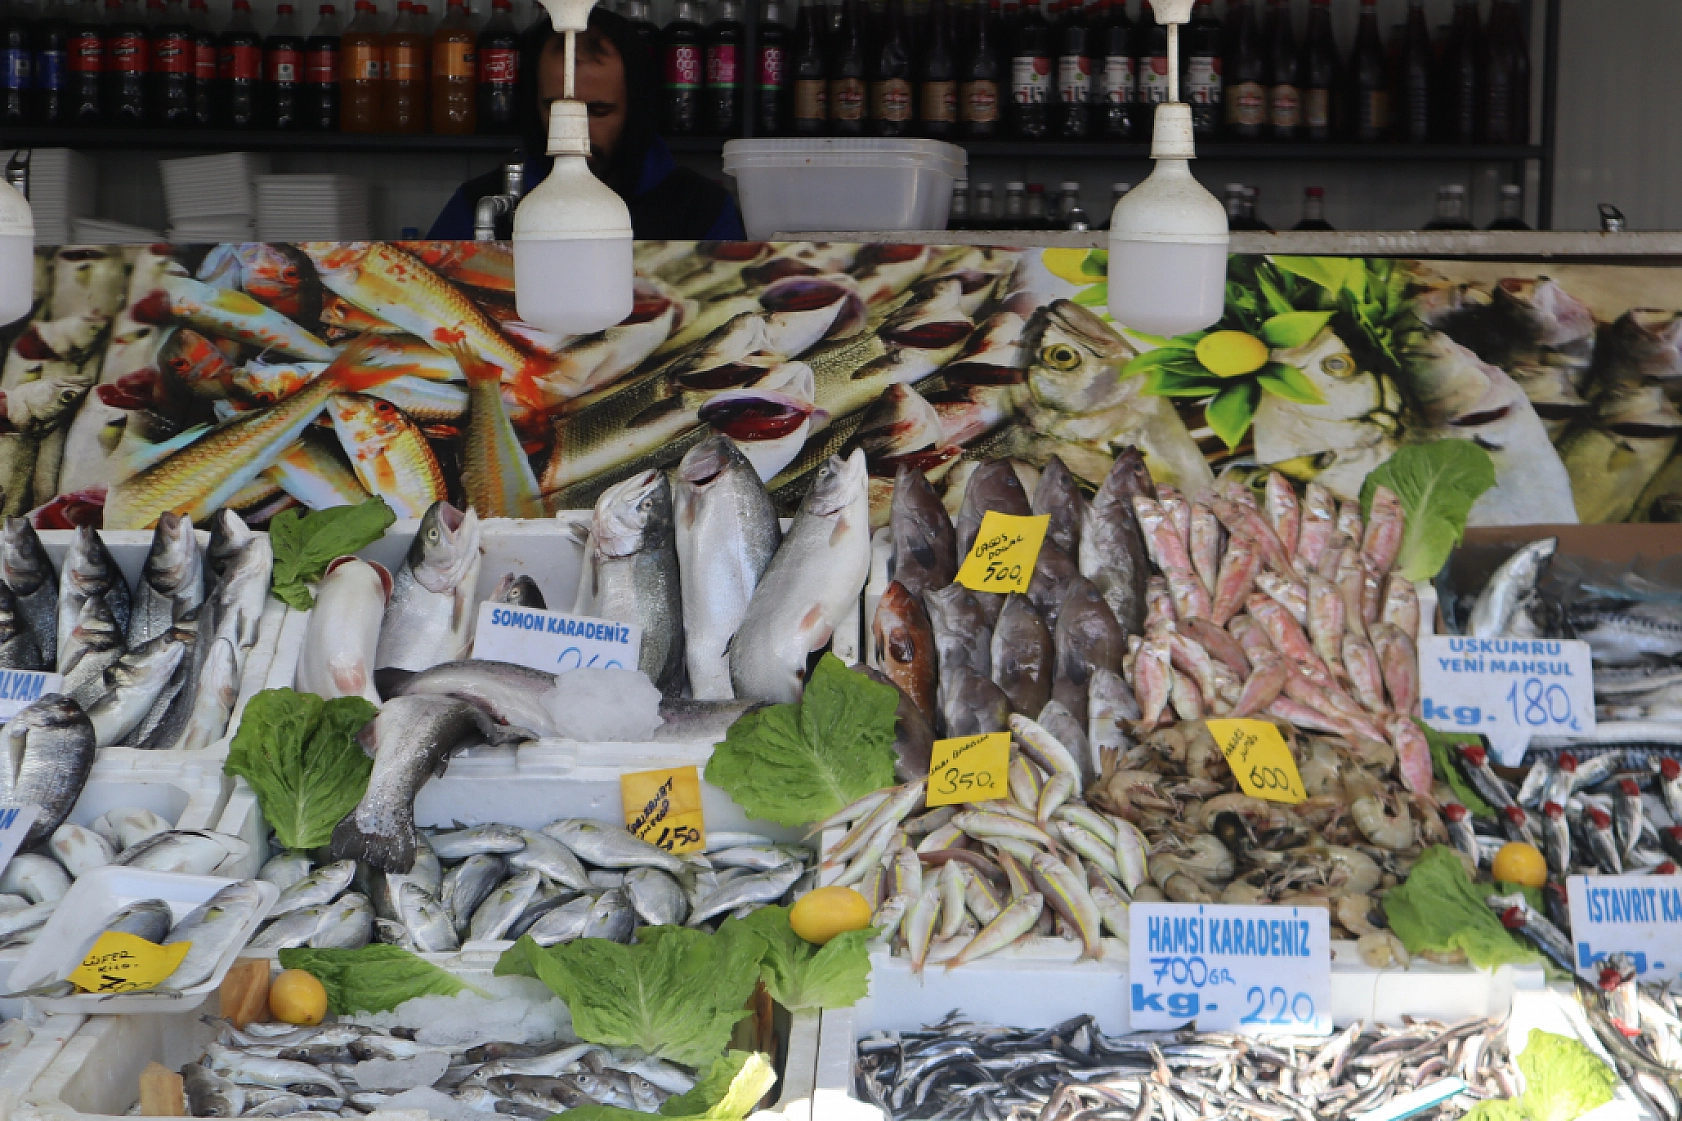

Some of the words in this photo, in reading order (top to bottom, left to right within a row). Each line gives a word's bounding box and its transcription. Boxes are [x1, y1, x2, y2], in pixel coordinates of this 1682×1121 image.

[492, 608, 544, 632] SOMON
[547, 617, 629, 644] KARADENİZ
[1449, 638, 1561, 656] USKUMRU
[1438, 654, 1484, 673] YENİ
[1490, 659, 1574, 676] MAHSUL
[1422, 697, 1497, 726] kg.
[1148, 904, 1204, 954] HAMSİ
[1209, 906, 1310, 957] KARADENİZ
